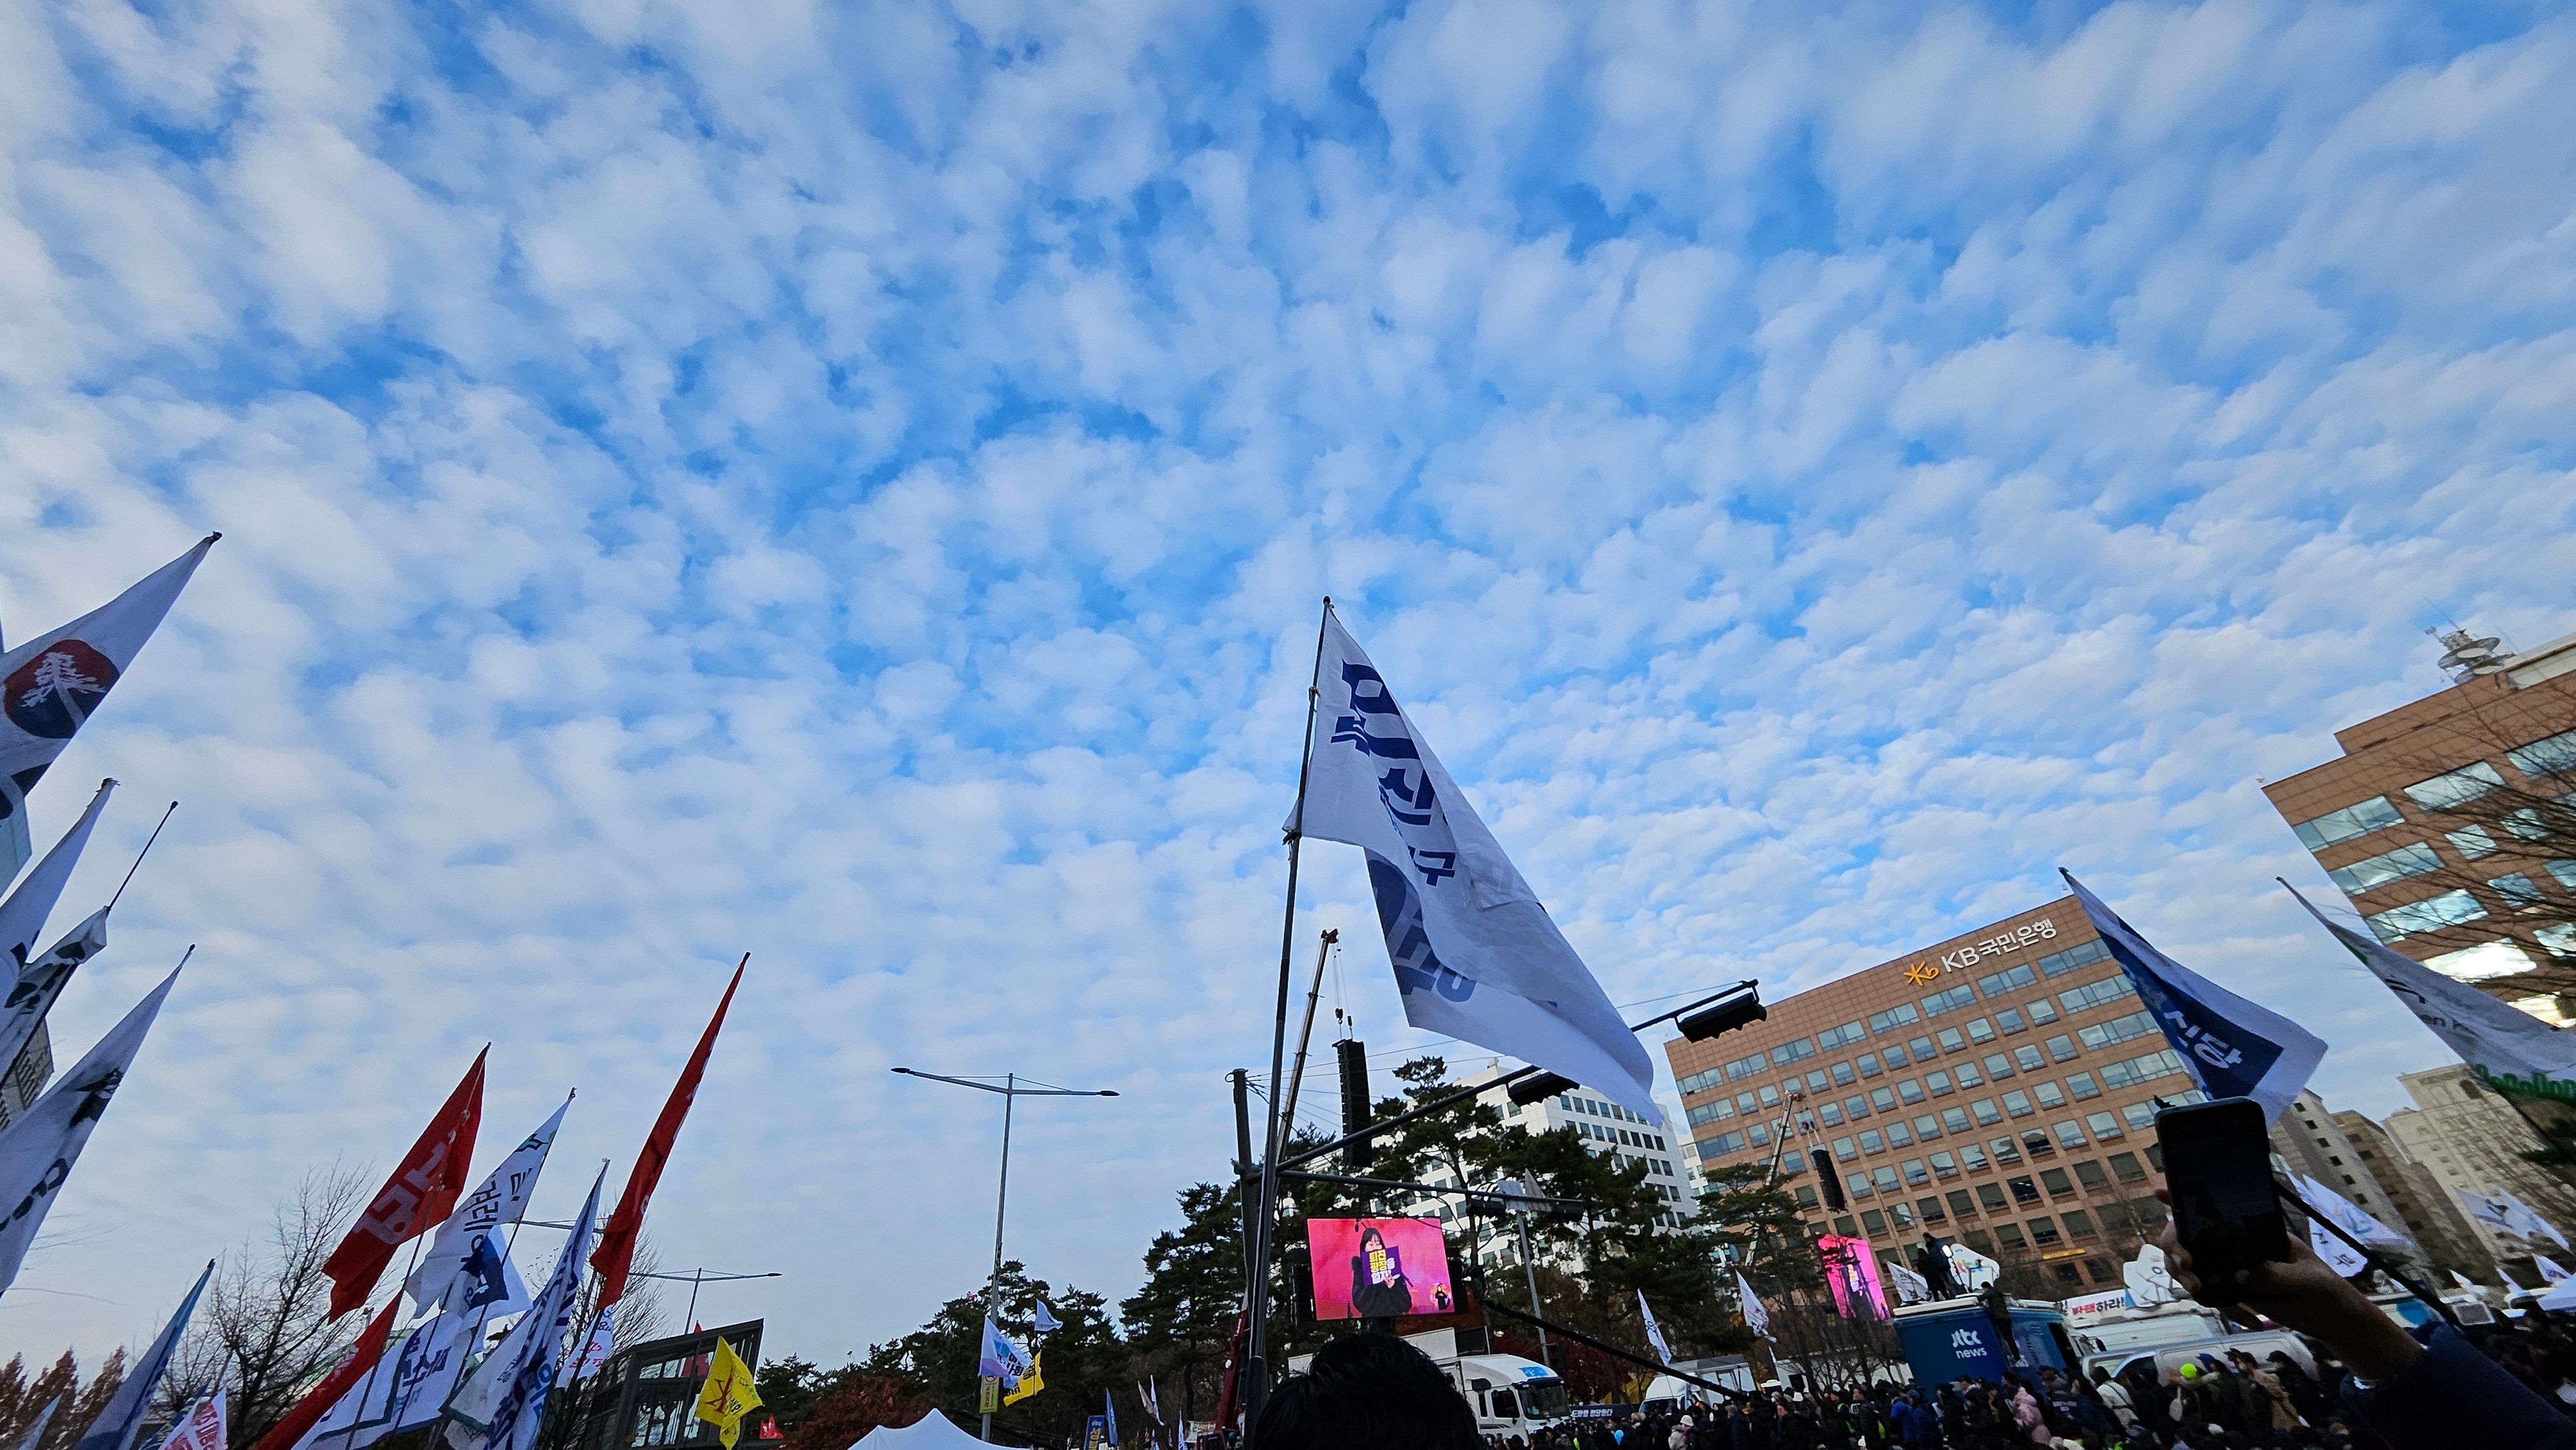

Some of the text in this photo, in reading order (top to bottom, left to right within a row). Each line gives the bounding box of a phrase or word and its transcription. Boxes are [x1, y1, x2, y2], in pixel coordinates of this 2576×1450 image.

[1941, 918, 2057, 973] KB국민은행
[1369, 1249, 1387, 1263] 퇴진
[1370, 1257, 1396, 1273] 광장을
[1955, 1347, 1987, 1359] news
